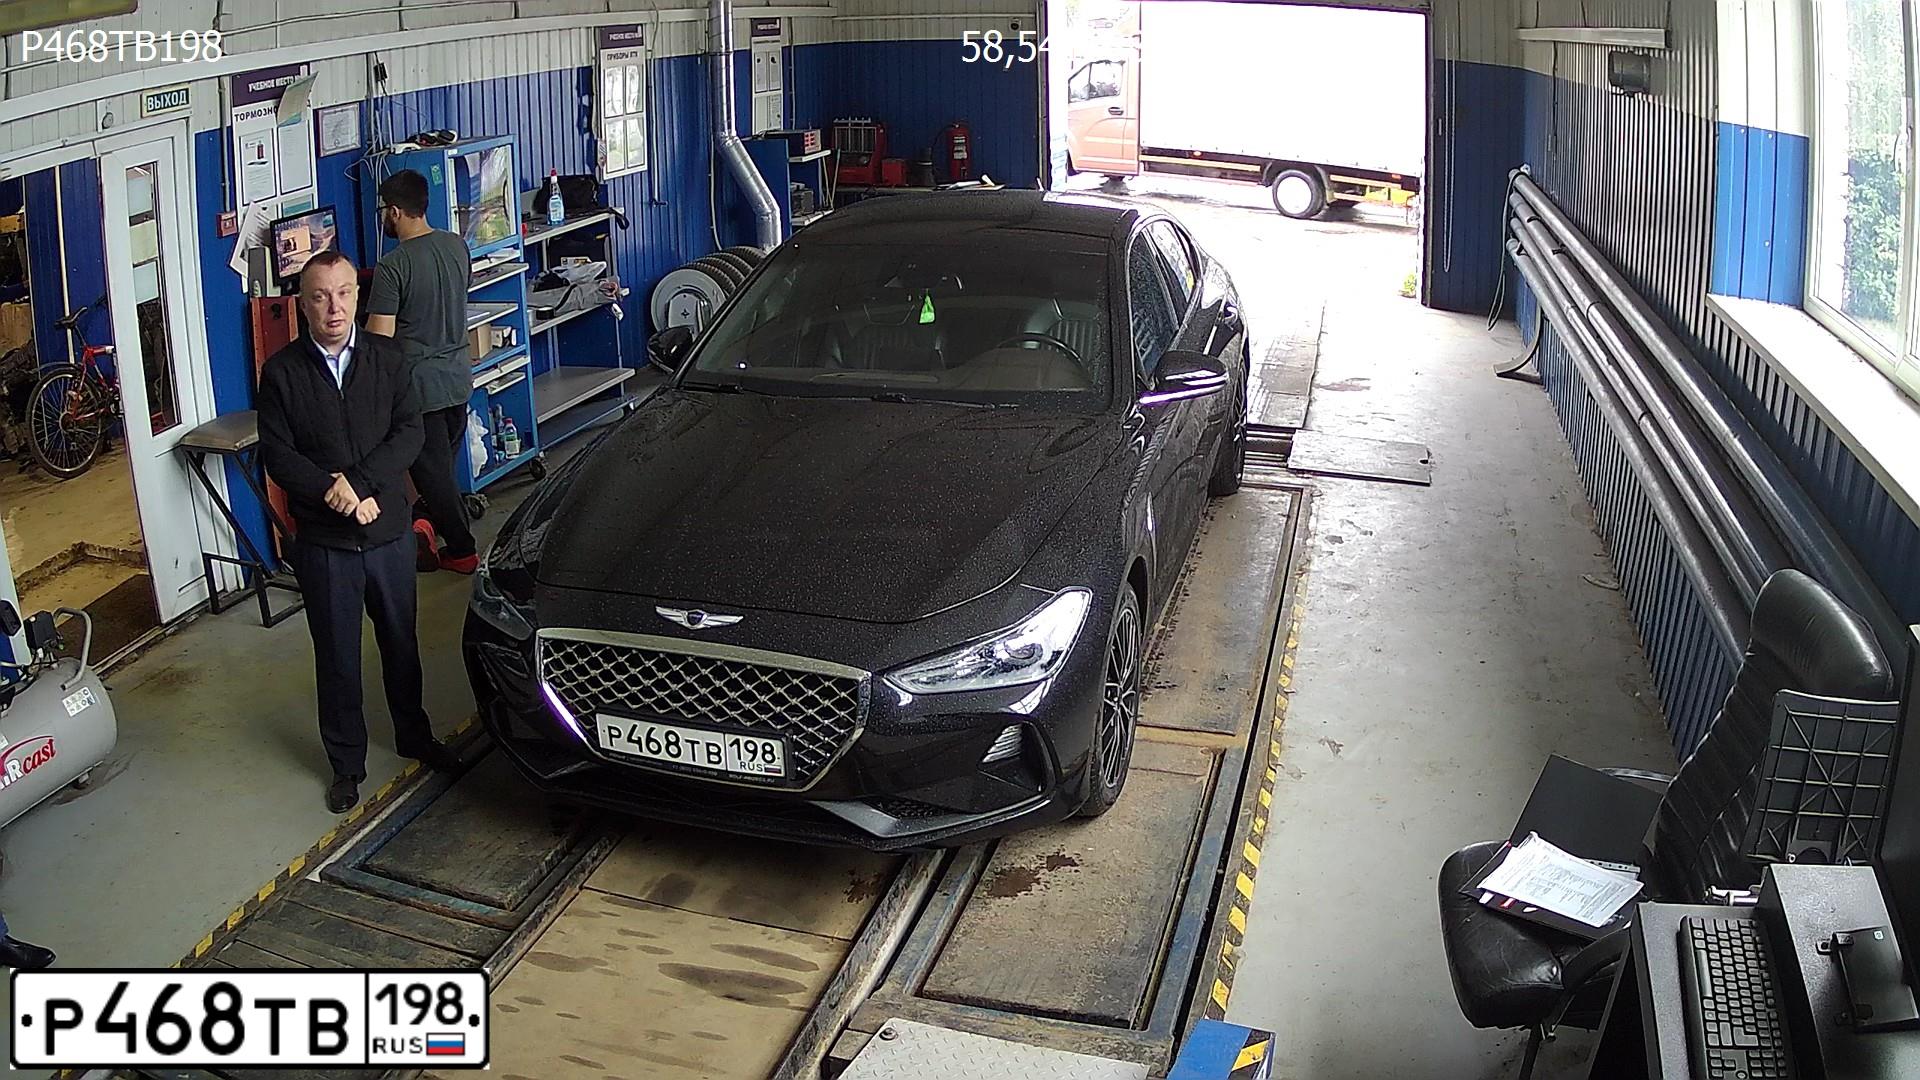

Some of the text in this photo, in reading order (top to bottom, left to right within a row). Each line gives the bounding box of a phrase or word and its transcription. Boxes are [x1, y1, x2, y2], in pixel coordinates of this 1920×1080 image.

[147, 90, 188, 111] ВЫХОД
[728, 737, 776, 764] 198
[739, 761, 763, 772] RUS
